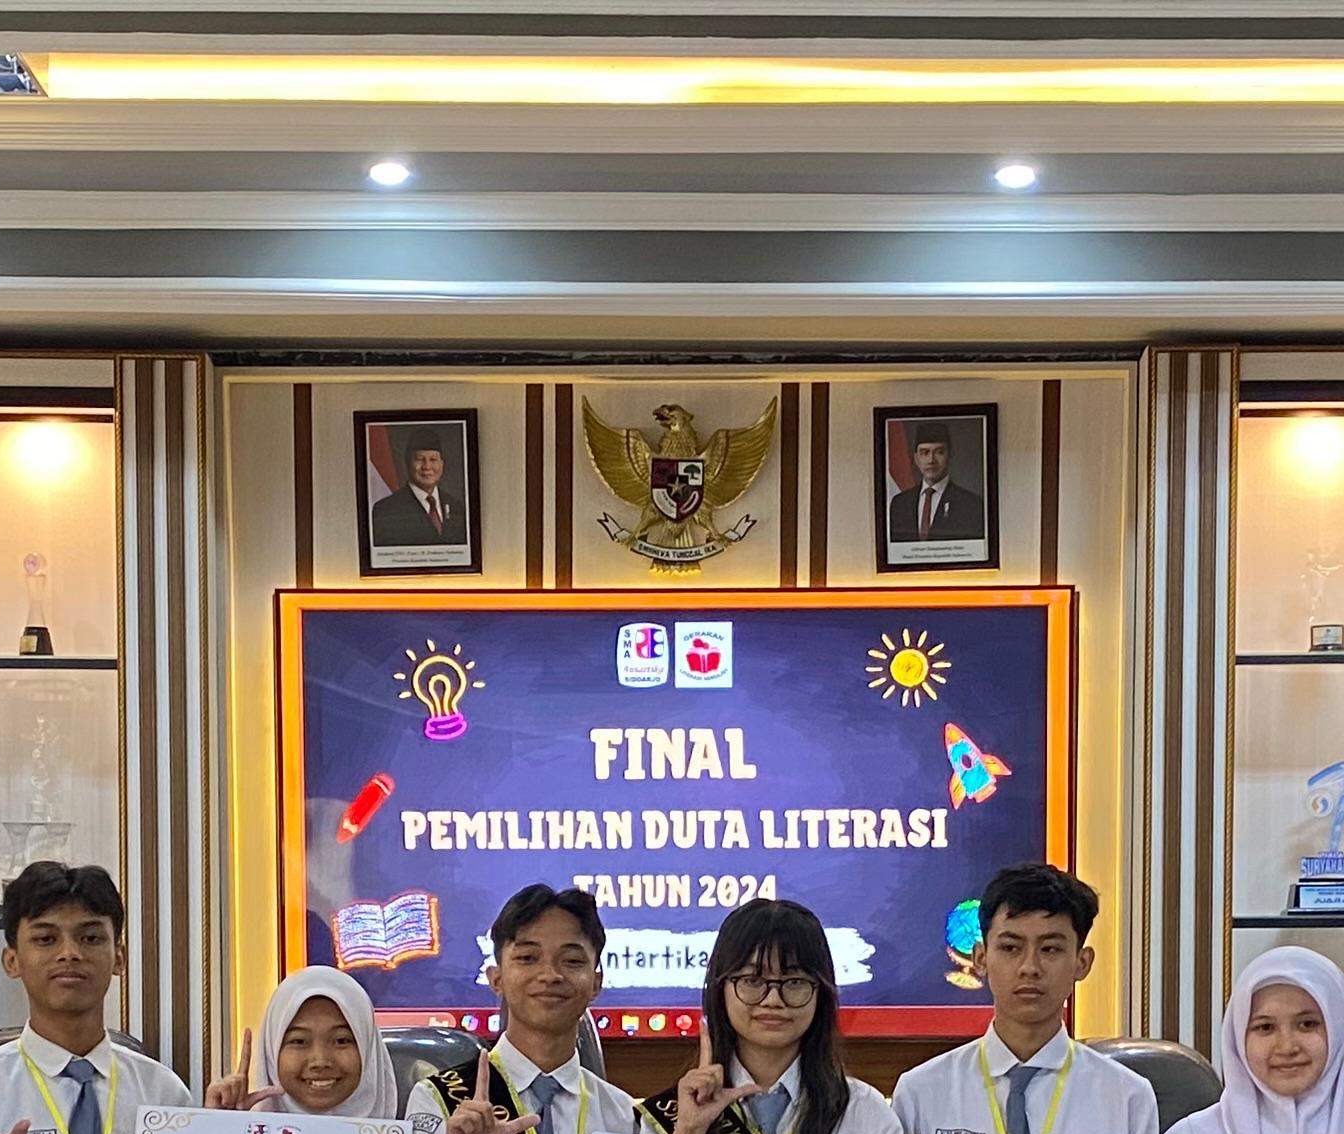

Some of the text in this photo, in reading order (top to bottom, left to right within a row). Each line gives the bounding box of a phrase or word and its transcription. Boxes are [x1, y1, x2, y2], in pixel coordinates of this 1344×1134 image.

[589, 727, 757, 780] FINAL
[400, 808, 948, 851] PEMILIHAN DUTA LITERASI
[572, 874, 777, 908] TAHUN 2024
[606, 945, 708, 970] ntartika
